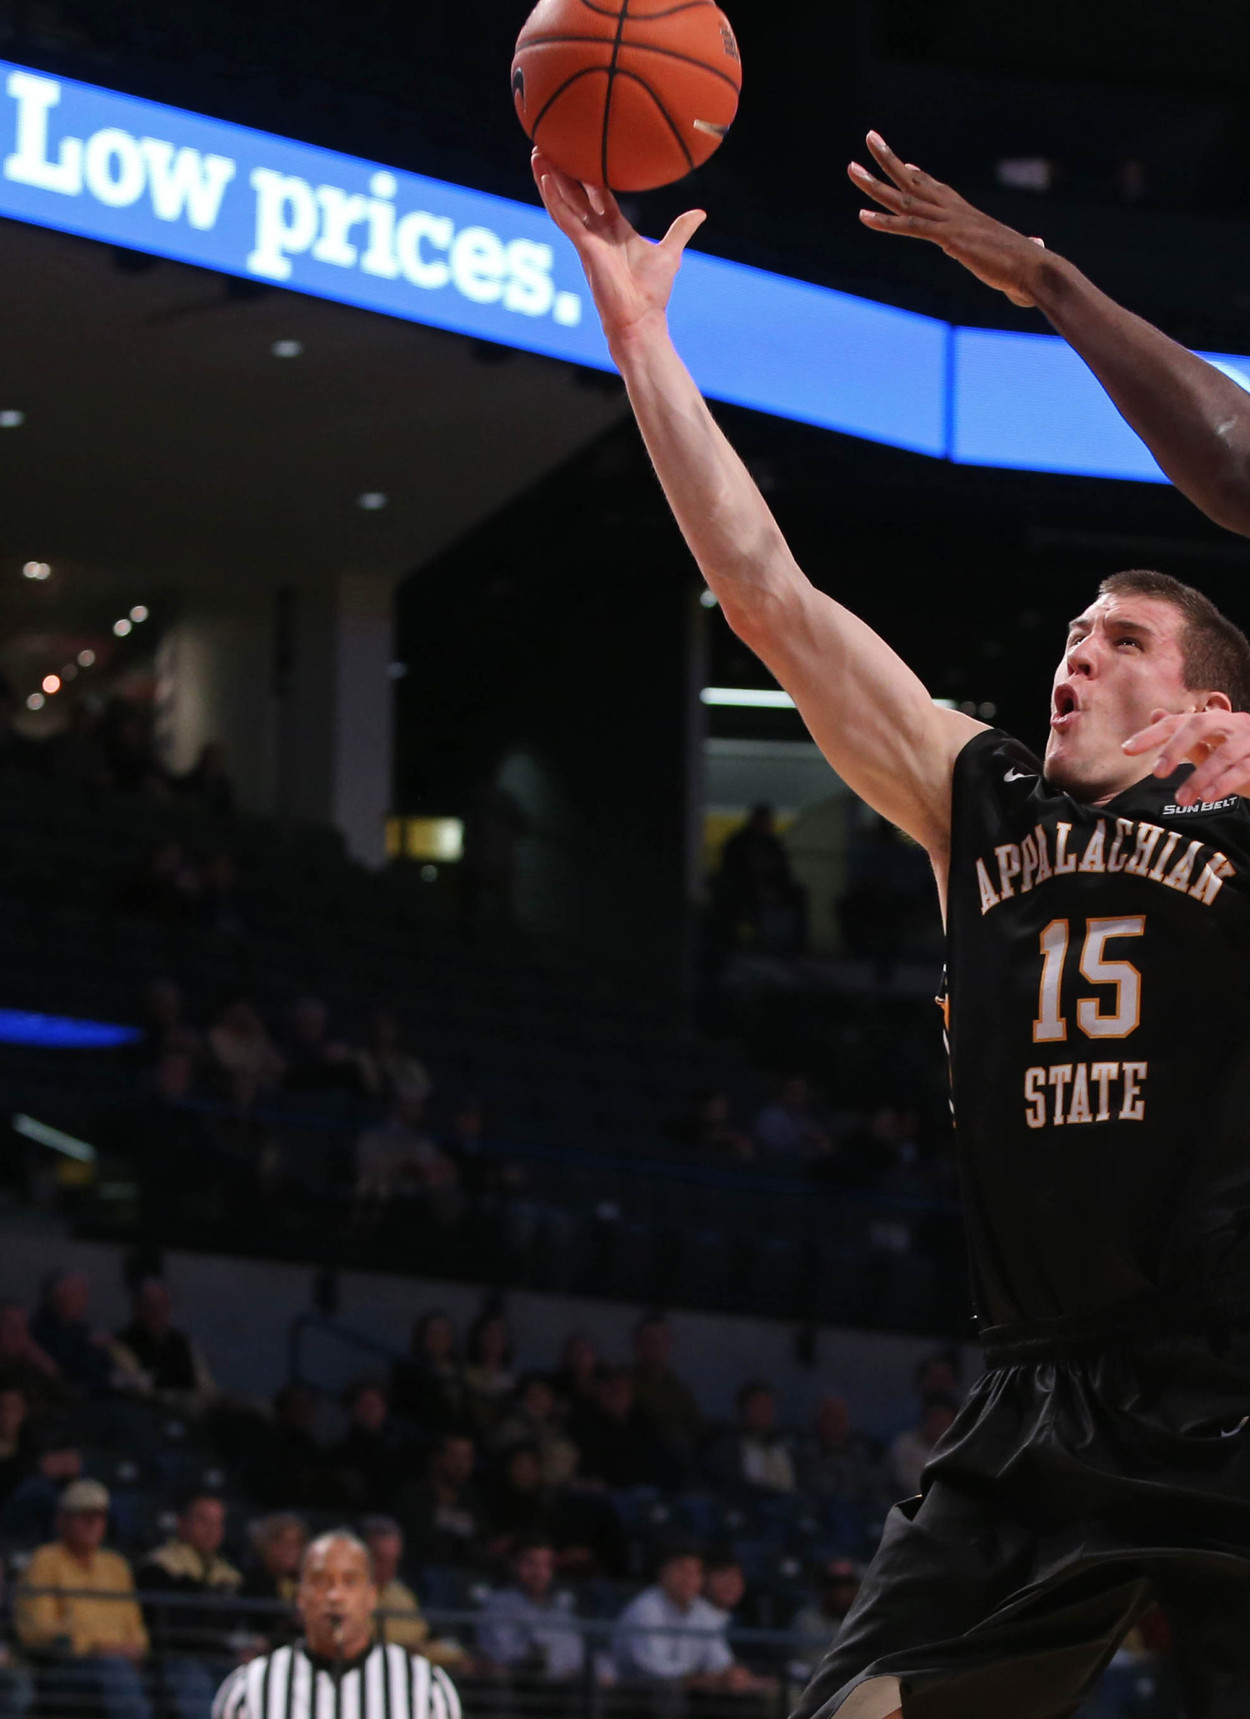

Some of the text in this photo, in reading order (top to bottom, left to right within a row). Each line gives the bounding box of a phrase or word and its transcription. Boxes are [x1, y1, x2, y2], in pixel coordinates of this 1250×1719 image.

[3, 69, 583, 328] Low prices.
[975, 818, 1238, 916] APPALACHIAN
[1032, 914, 1147, 1044] 15
[1023, 1060, 1149, 1129] STATE
